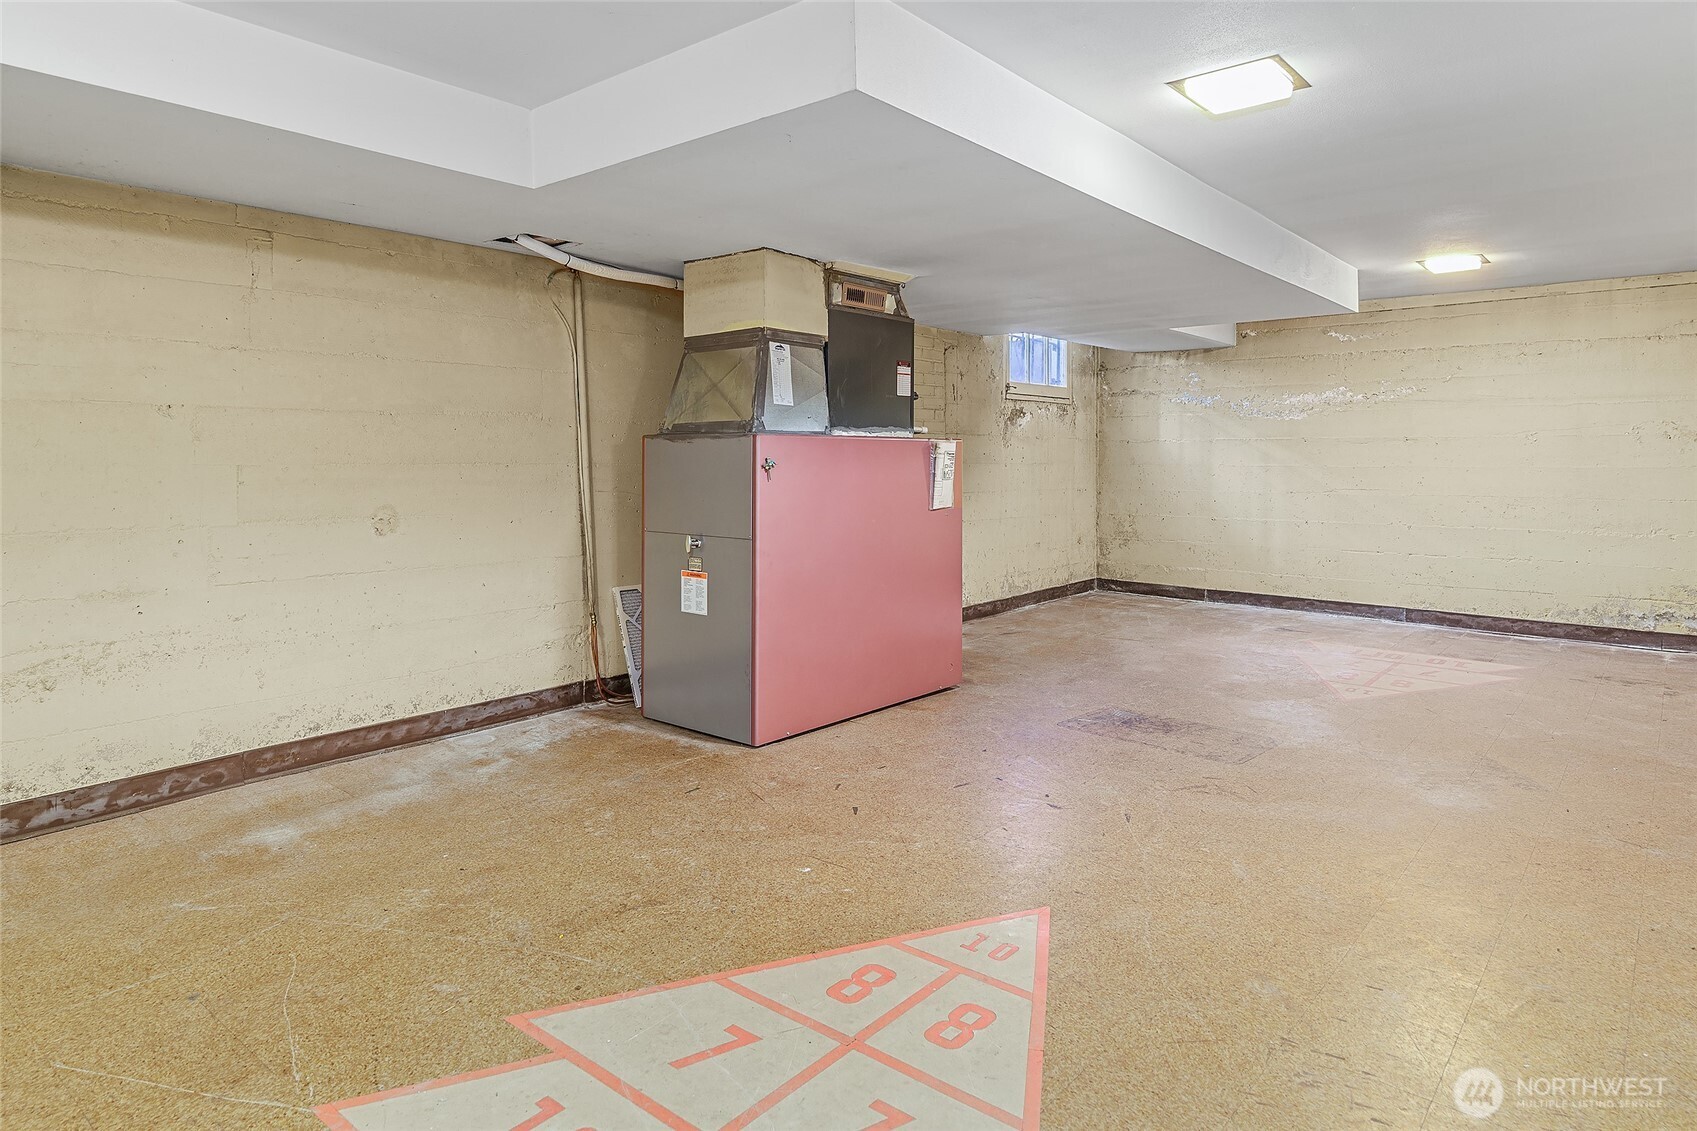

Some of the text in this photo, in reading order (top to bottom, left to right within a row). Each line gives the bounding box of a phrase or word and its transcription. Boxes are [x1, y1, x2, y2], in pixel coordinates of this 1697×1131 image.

[960, 932, 1020, 961] 10
[826, 963, 897, 1004] 8
[924, 1003, 997, 1050] 8
